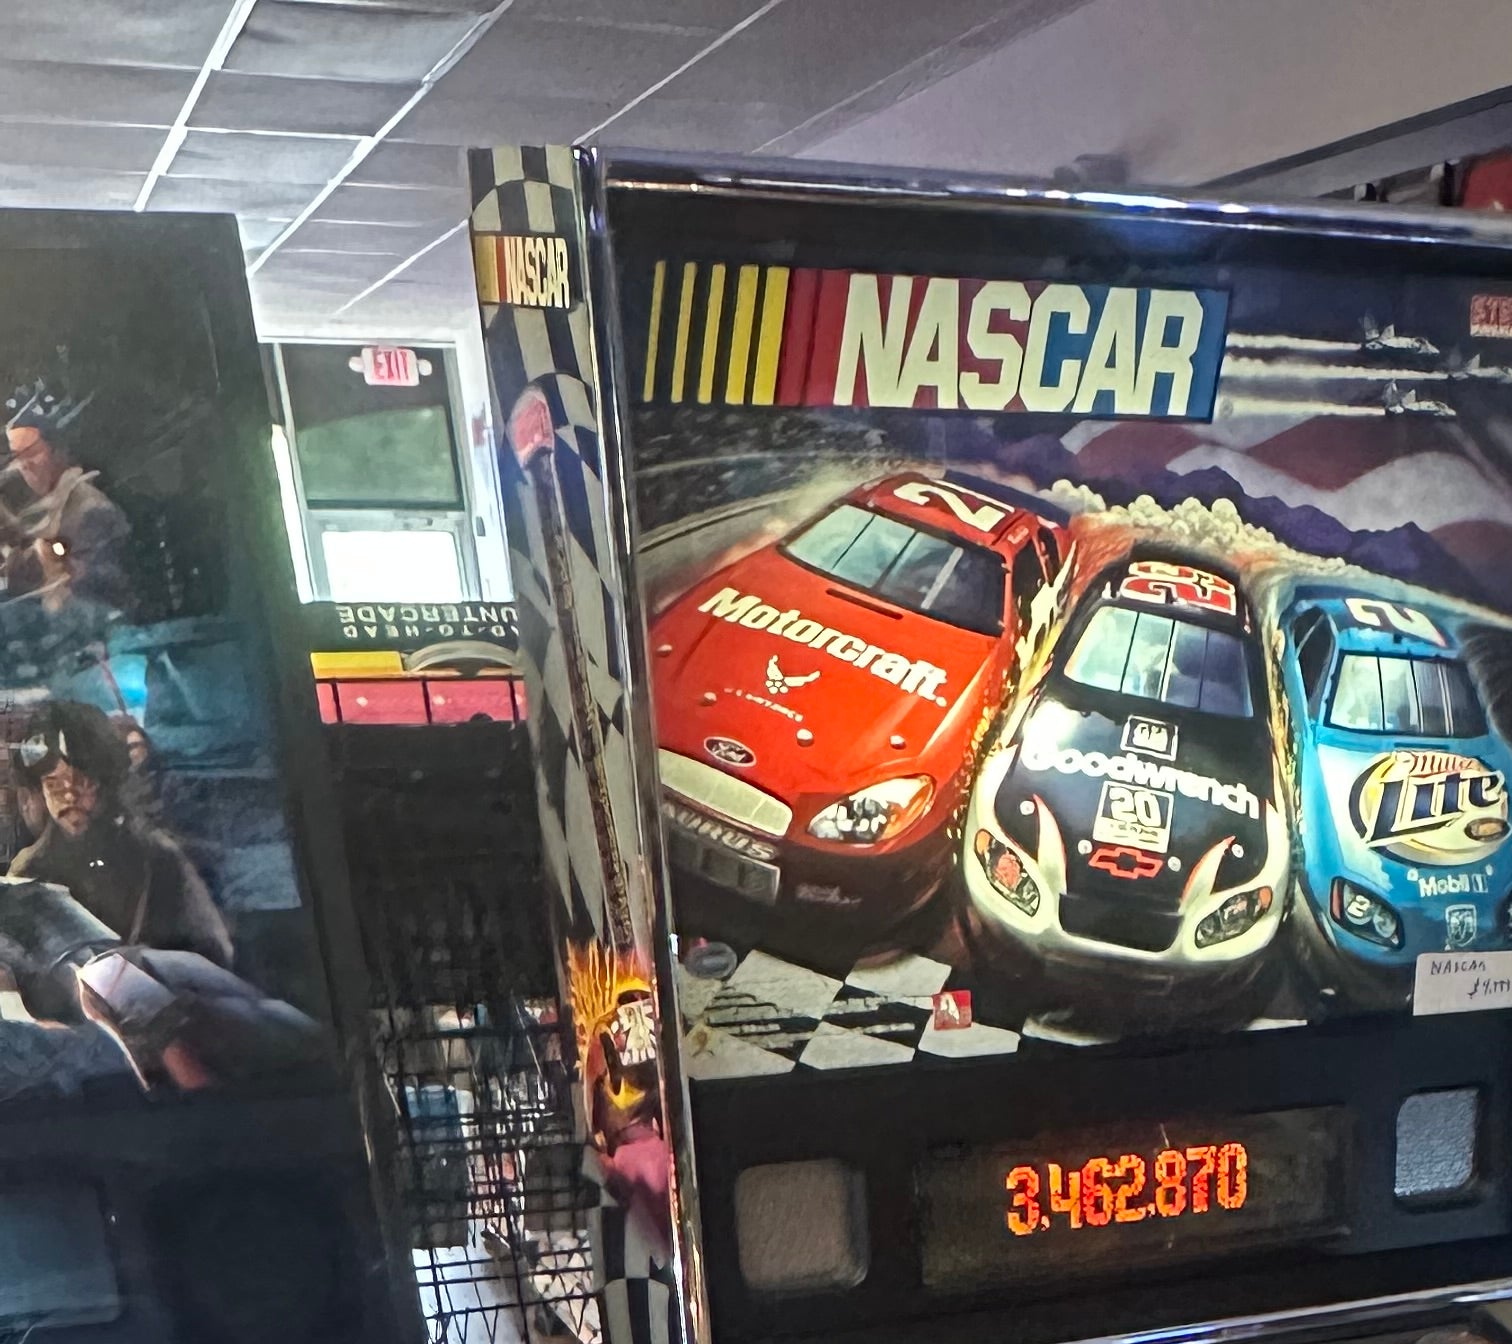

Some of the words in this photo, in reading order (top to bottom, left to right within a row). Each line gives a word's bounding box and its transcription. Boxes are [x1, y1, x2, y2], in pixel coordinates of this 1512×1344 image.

[503, 236, 569, 309] NASCAR
[372, 350, 410, 381] EXIT
[834, 273, 1203, 416] NASCAR
[1345, 597, 1447, 647] 2
[1109, 786, 1162, 827] 20
[1366, 770, 1507, 843] Lite
